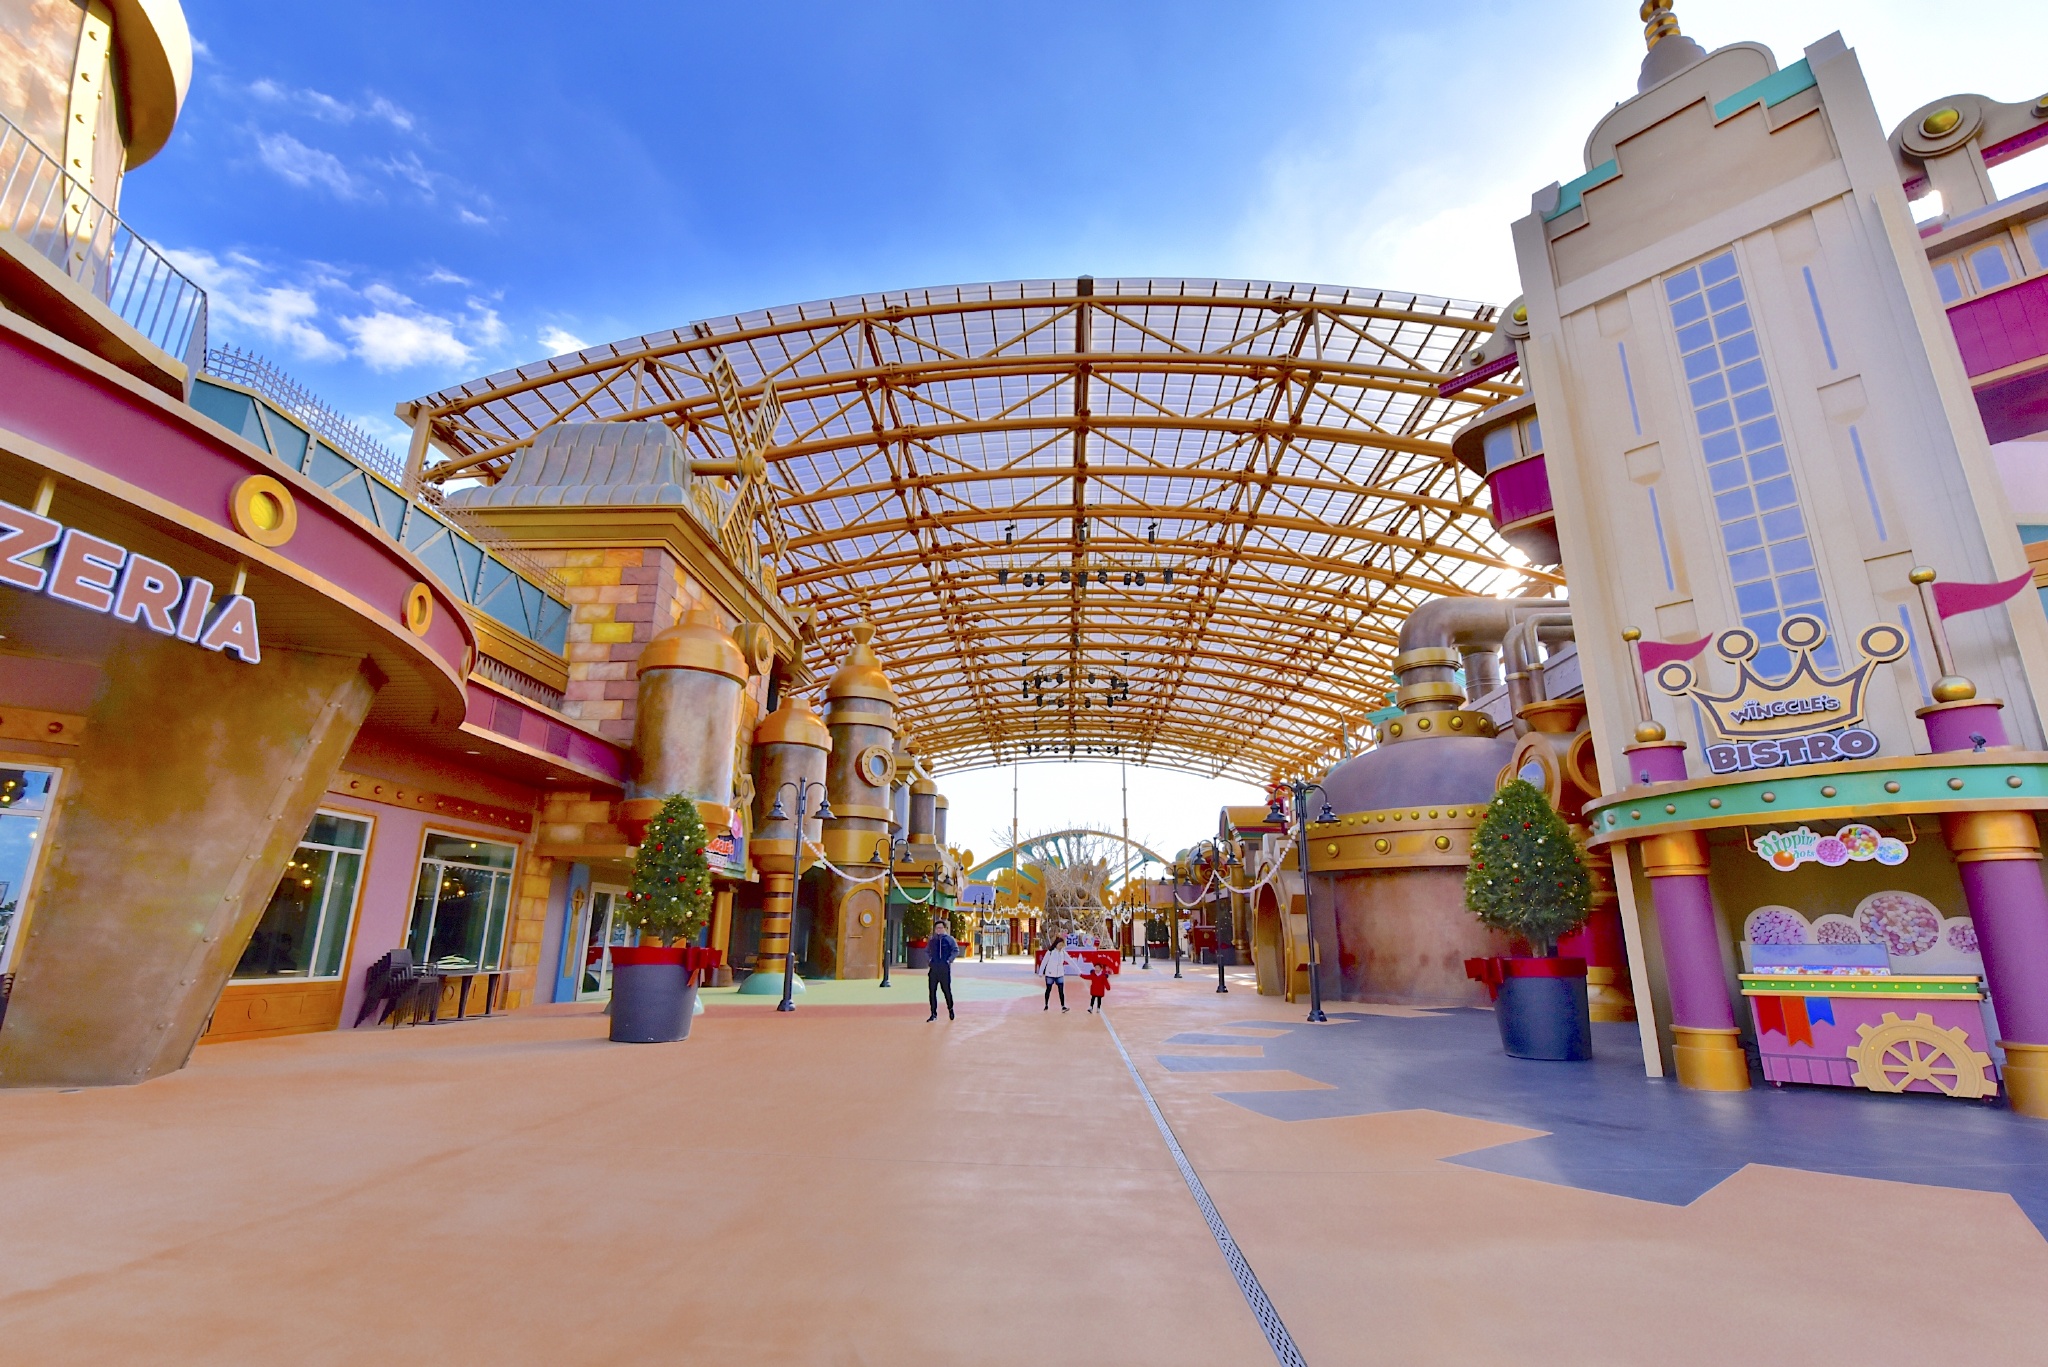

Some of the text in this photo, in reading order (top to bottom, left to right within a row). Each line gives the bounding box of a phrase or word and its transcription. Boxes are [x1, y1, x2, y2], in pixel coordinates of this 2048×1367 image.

[0, 501, 260, 664] ZERIA
[1706, 730, 1878, 773] BISTRO
[1793, 848, 1815, 858] dots
